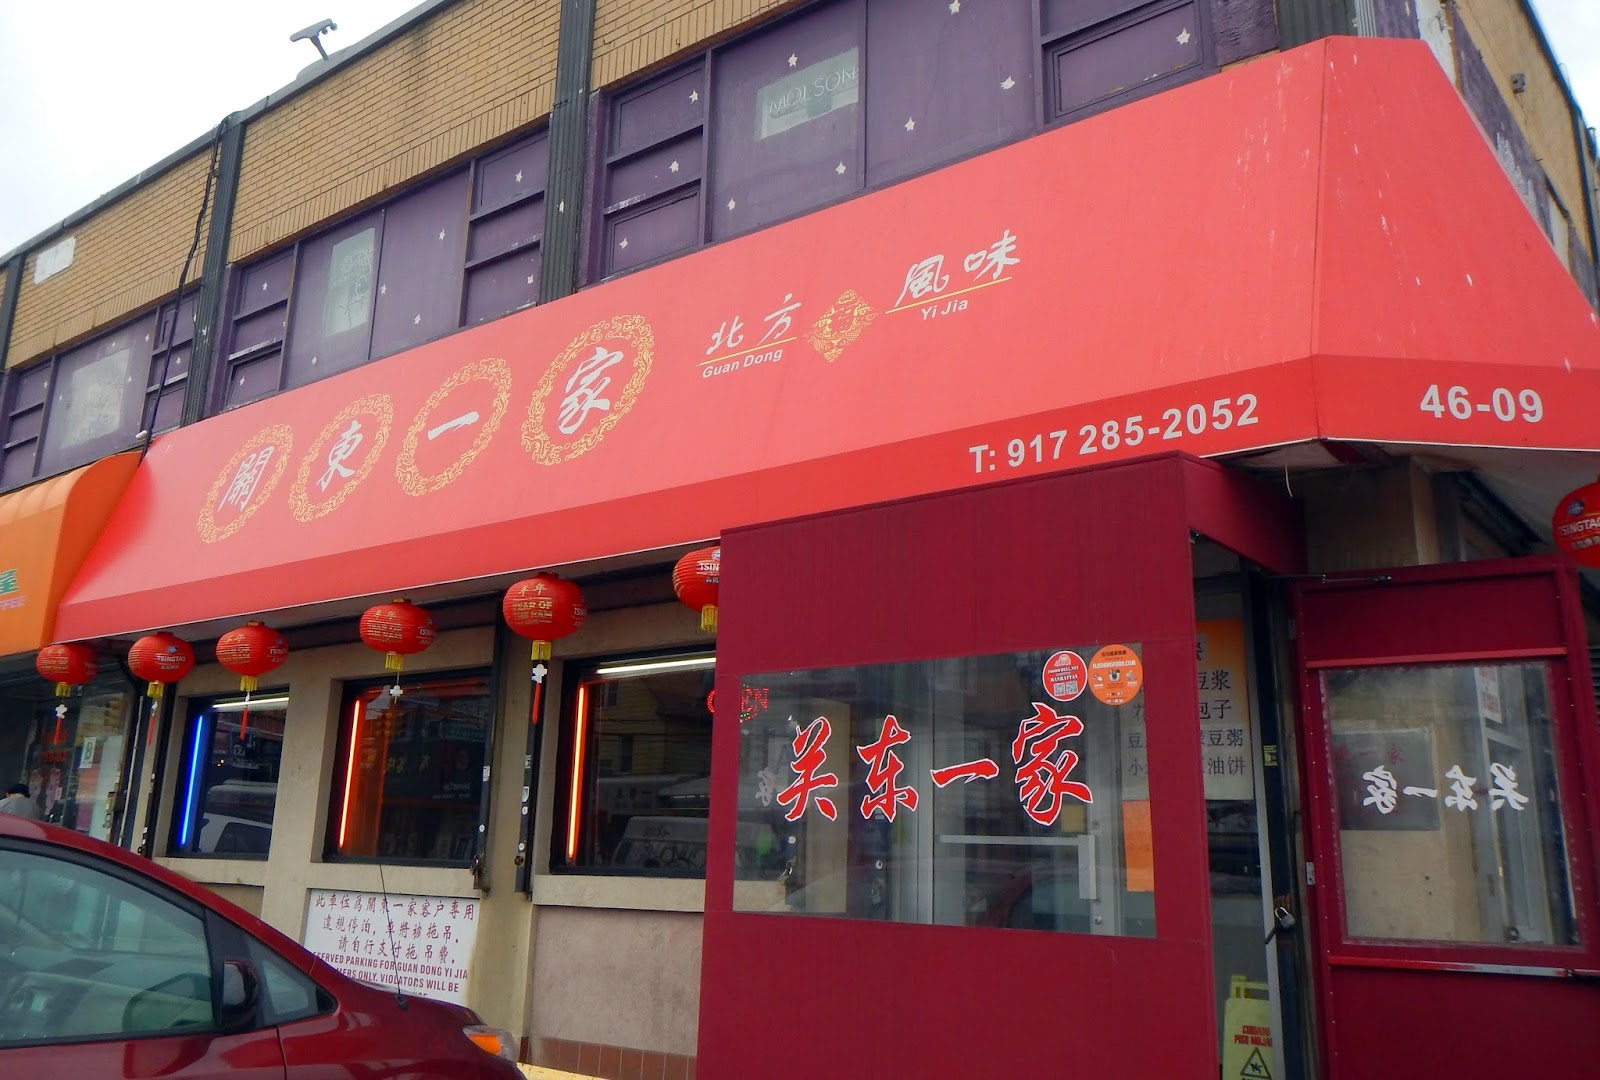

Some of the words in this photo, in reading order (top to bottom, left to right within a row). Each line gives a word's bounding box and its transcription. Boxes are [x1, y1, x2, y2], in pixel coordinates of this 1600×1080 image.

[769, 66, 856, 114] MOLSON
[705, 293, 802, 356] 北方
[894, 229, 1021, 308] 風味
[702, 358, 740, 379] Guan
[742, 349, 784, 368] Dong
[920, 305, 938, 321] Yi
[941, 299, 969, 316] Jia
[1419, 384, 1544, 423] 46-09
[969, 444, 996, 473] T:
[1007, 430, 1067, 467] 917
[1078, 393, 1259, 456] 285-2052
[777, 702, 1093, 826] 关东一家
[1201, 756, 1245, 776] 油饼
[345, 955, 378, 968] PARKING
[380, 960, 395, 970] FOR
[397, 961, 418, 973] GUAN
[420, 964, 442, 976] DONG
[444, 967, 453, 977] YI
[454, 968, 468, 979] JIA
[380, 974, 424, 988] VIOLATORS
[426, 979, 446, 991] WILL
[448, 982, 459, 993] BE
